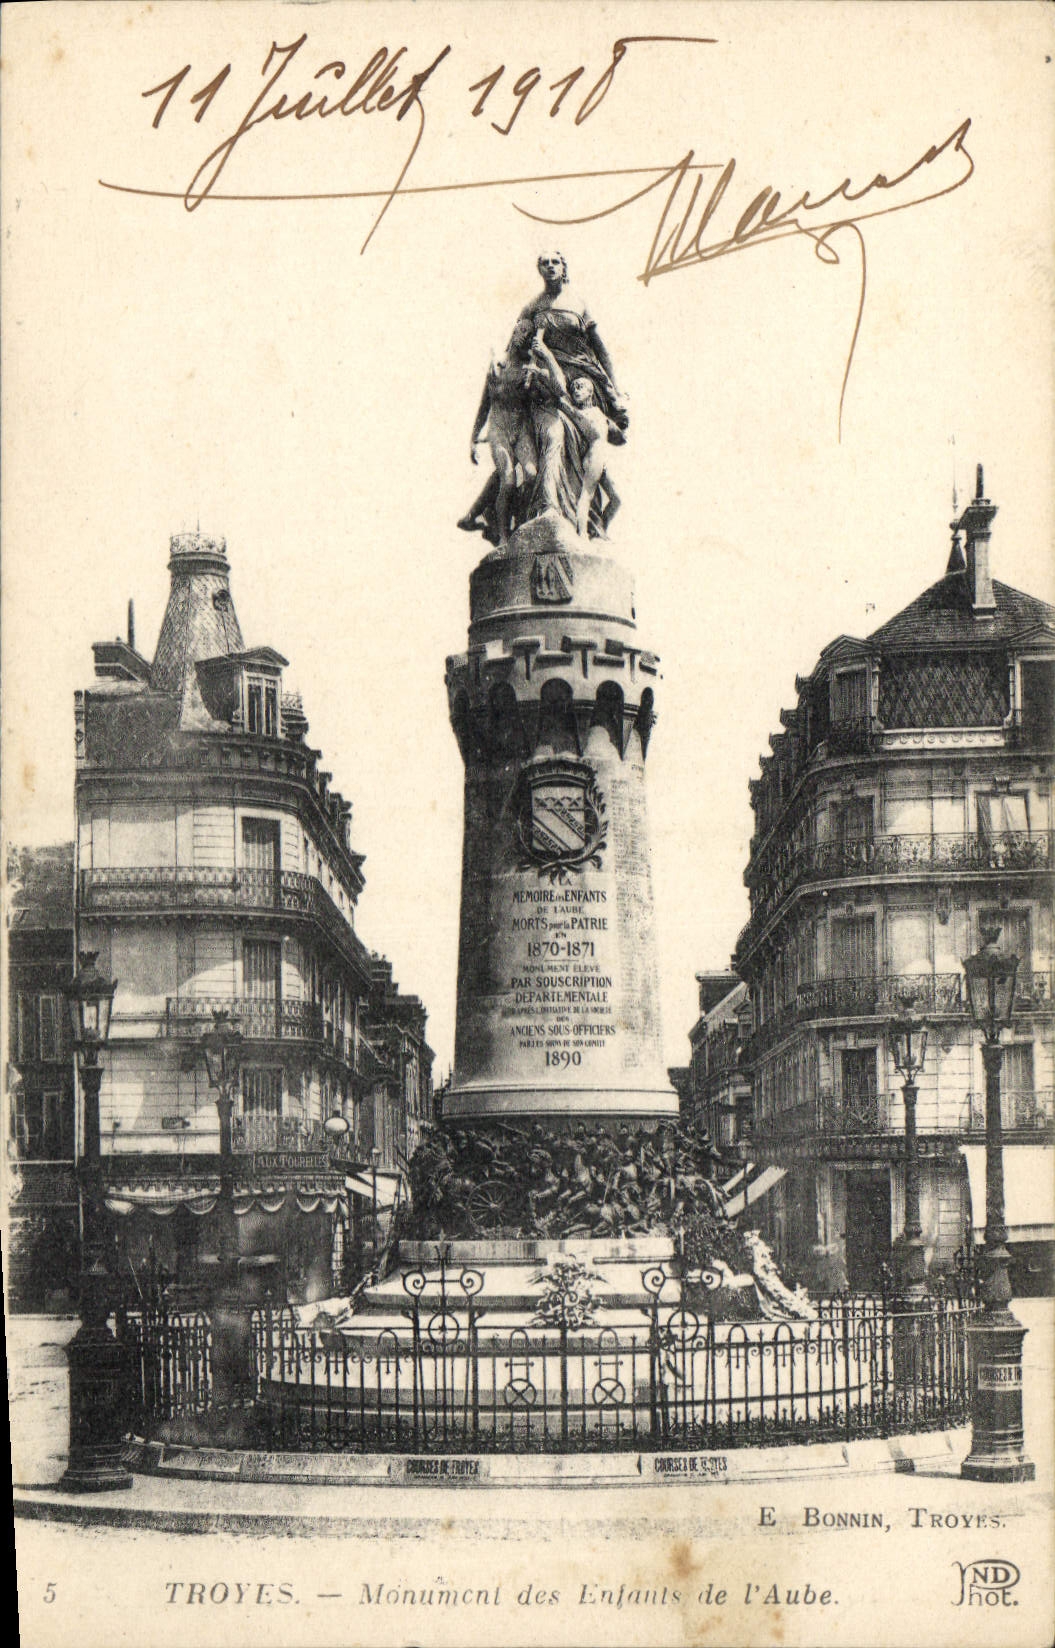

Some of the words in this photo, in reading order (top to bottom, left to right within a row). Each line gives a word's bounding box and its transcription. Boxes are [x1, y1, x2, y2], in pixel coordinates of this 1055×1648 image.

[565, 889, 607, 902] ENFANTS
[537, 906, 549, 914] DE
[512, 917, 548, 931] MORTS
[571, 917, 608, 930] PATRIE
[528, 941, 595, 960] 1870-1871
[523, 965, 569, 973] MONUMENT
[511, 977, 531, 989] PAR
[536, 976, 612, 988] SOUSCRIPTION
[511, 1024, 546, 1037] ANCIENS
[545, 1051, 582, 1070] 1890
[256, 1155, 279, 1168] AUX
[280, 1154, 329, 1168] TOURELLES
[441, 1460, 450, 1474] DE
[654, 1457, 688, 1472] COURSES
[689, 1457, 699, 1471] DE
